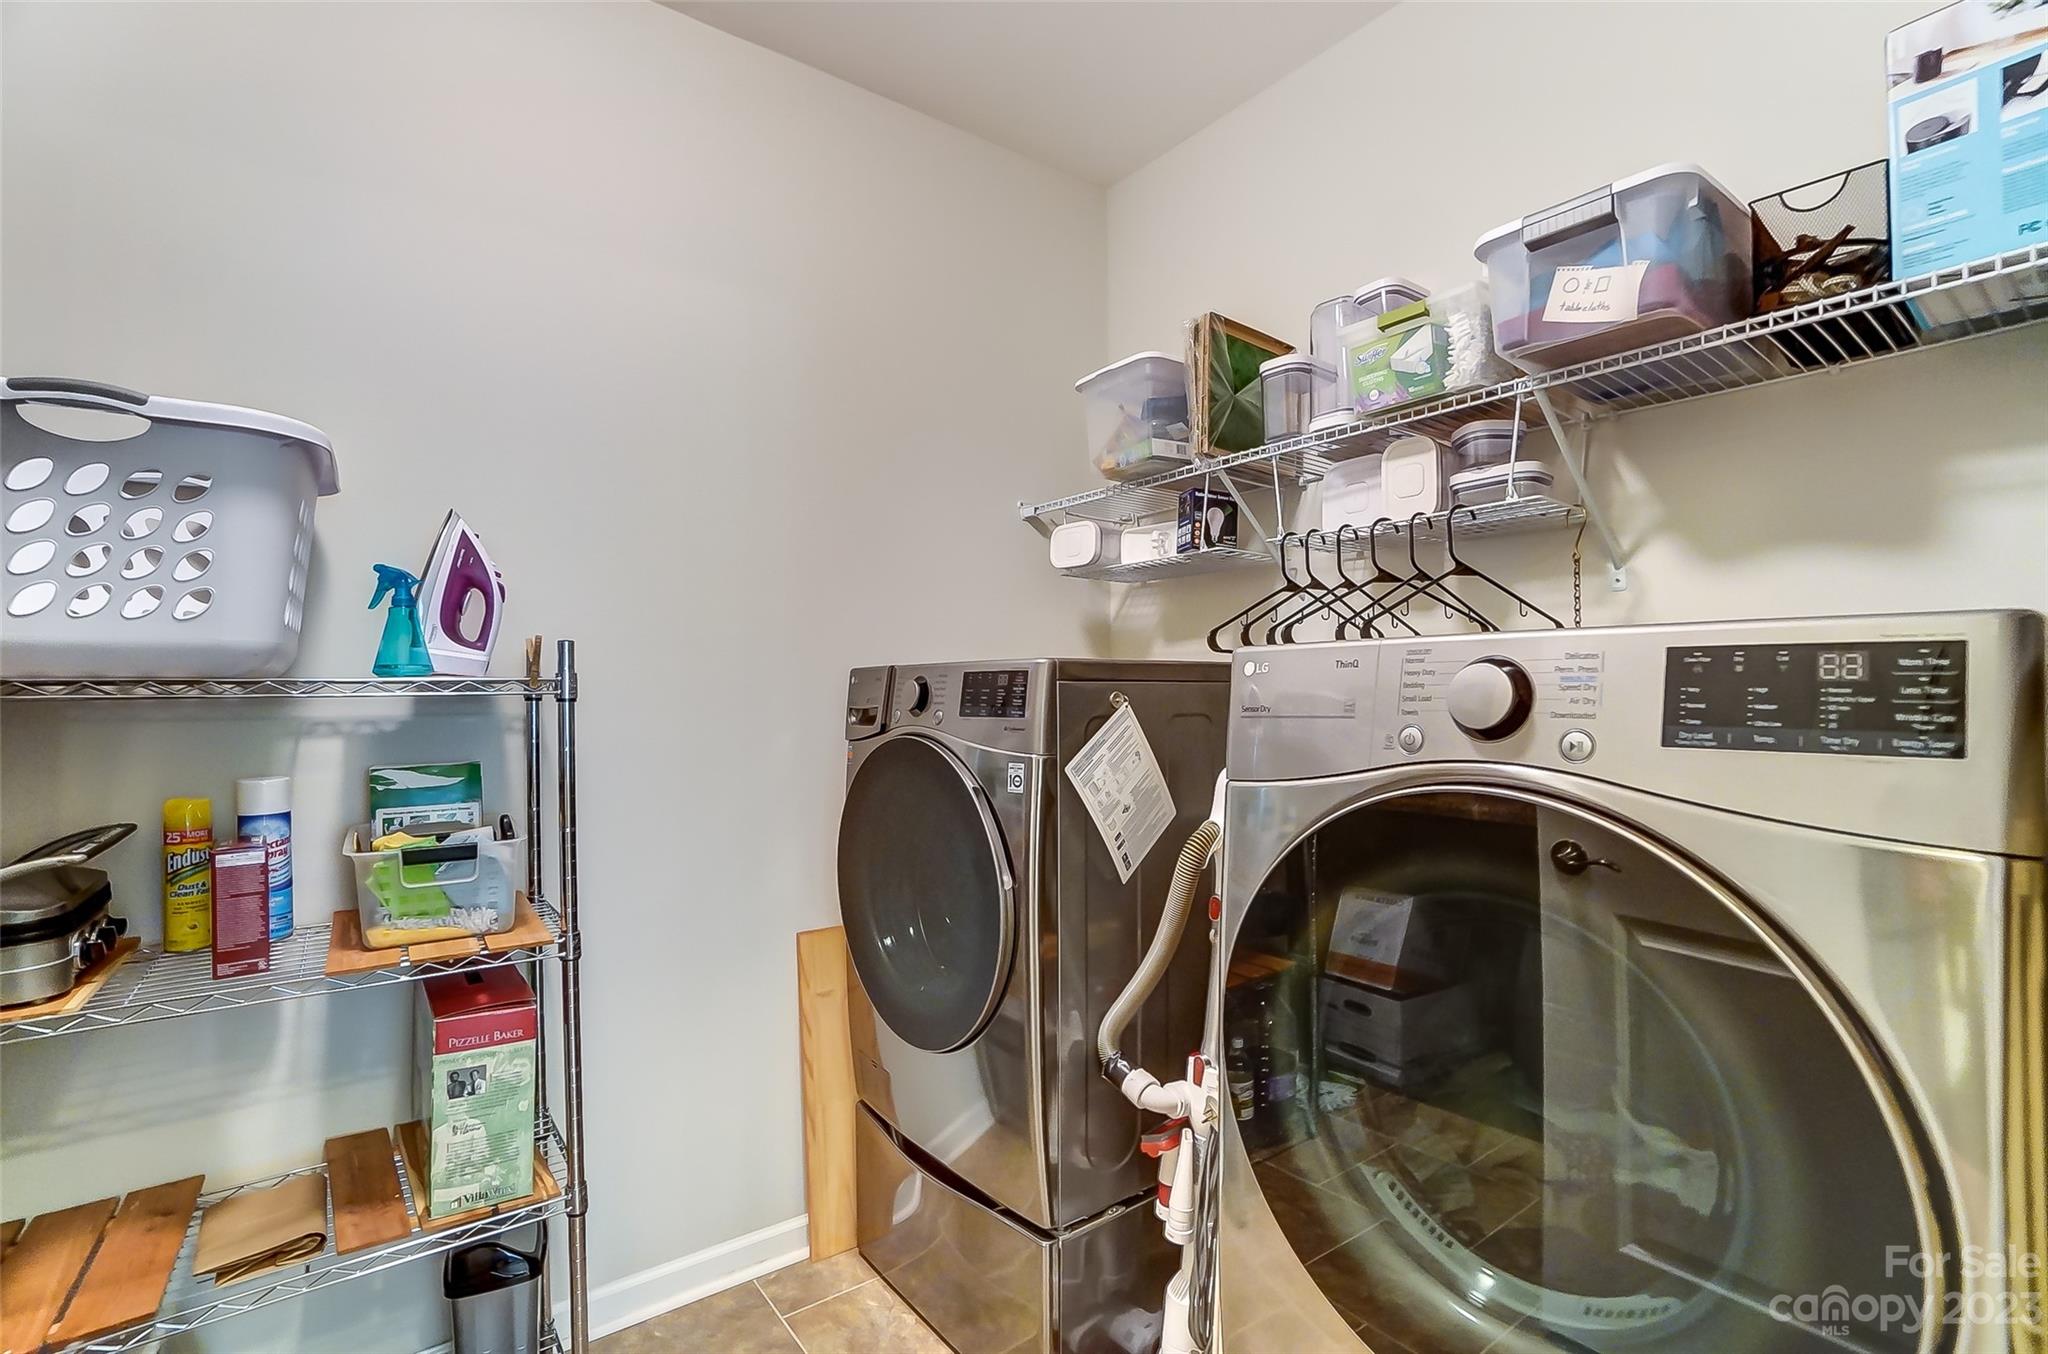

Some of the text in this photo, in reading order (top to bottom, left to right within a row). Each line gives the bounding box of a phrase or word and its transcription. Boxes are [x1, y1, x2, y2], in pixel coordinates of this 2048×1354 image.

[1564, 652, 1599, 660] Delicates
[1336, 659, 1359, 669] ThinQ
[1256, 663, 1270, 674] LG
[1422, 669, 1435, 677] Duty
[1582, 683, 1597, 692] Dry
[1582, 697, 1596, 706] Dry
[1241, 705, 1271, 713] Sensor Dry
[177, 883, 201, 891] Dust
[170, 890, 194, 898] Clean
[448, 1028, 524, 1049] PIZZELLE BAKER
